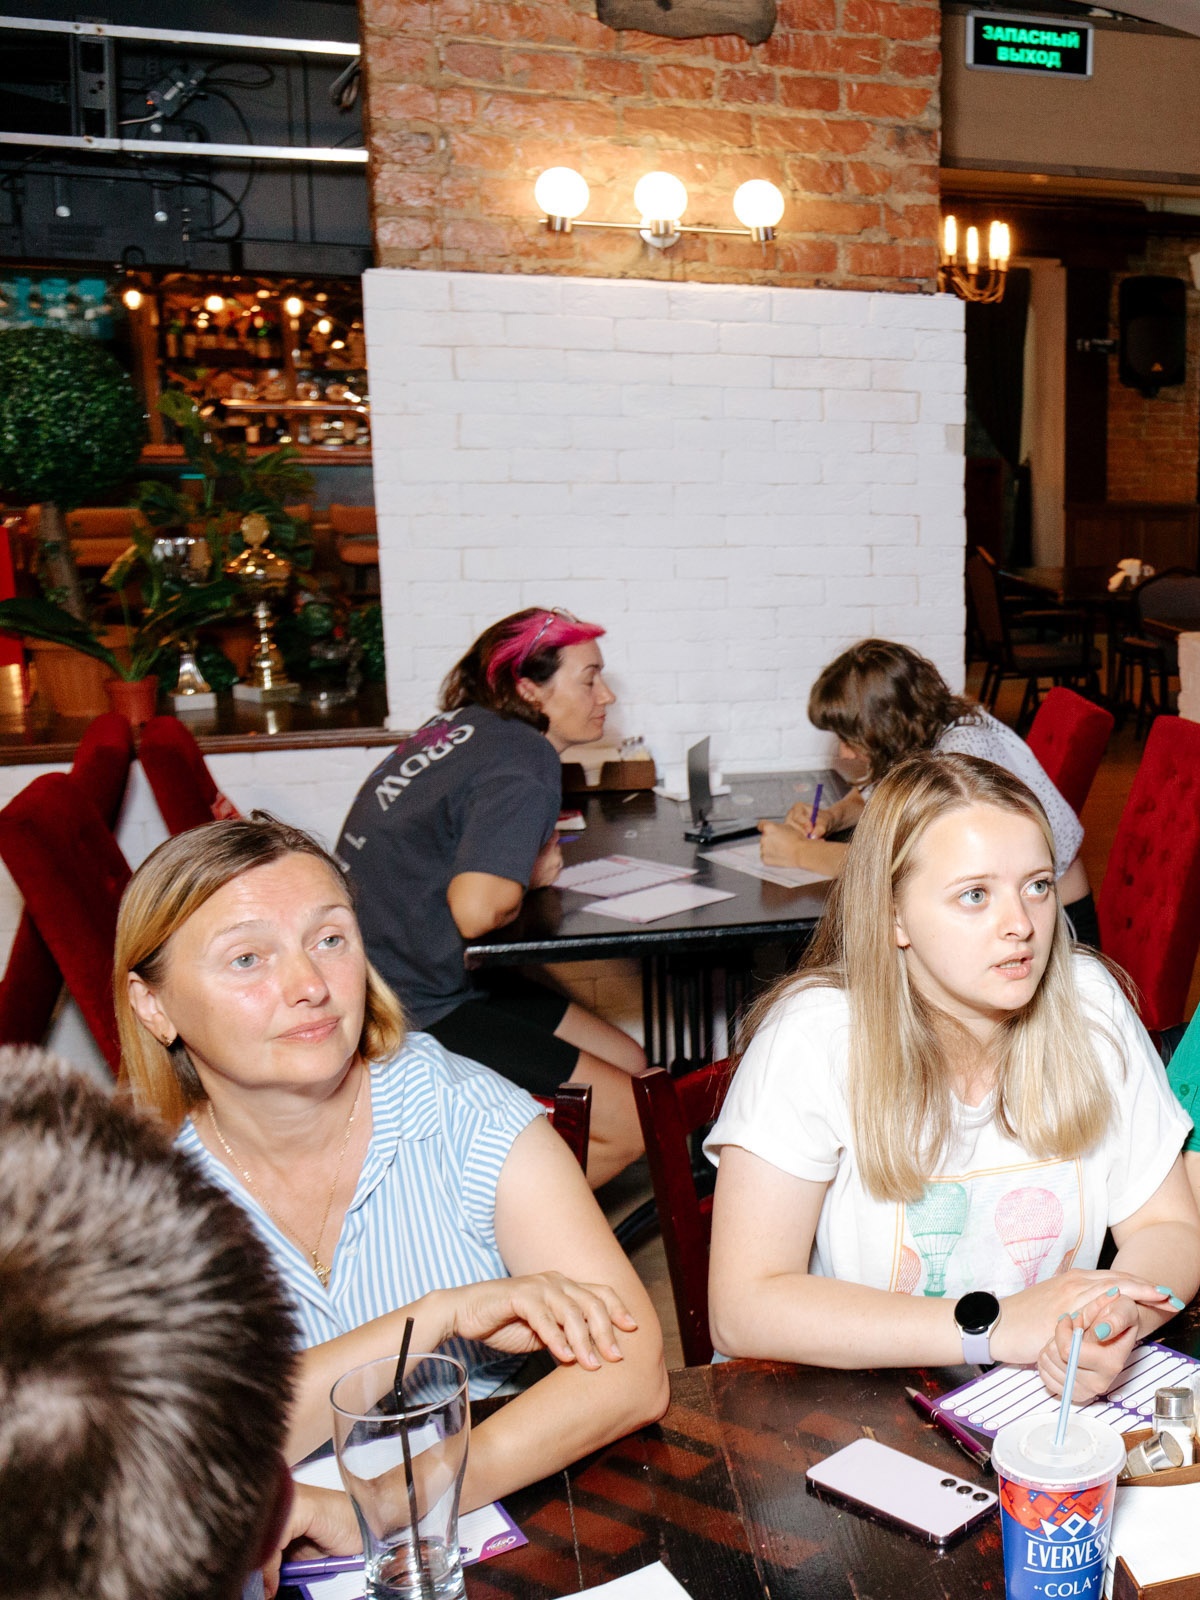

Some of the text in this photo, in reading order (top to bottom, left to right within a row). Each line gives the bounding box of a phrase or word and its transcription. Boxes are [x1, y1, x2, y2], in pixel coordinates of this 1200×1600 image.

[982, 25, 1080, 48] ЗАПАСНЫЙ
[997, 46, 1062, 68] ВЫХОД
[375, 724, 475, 812] GROW
[1044, 1577, 1092, 1598] COLA
